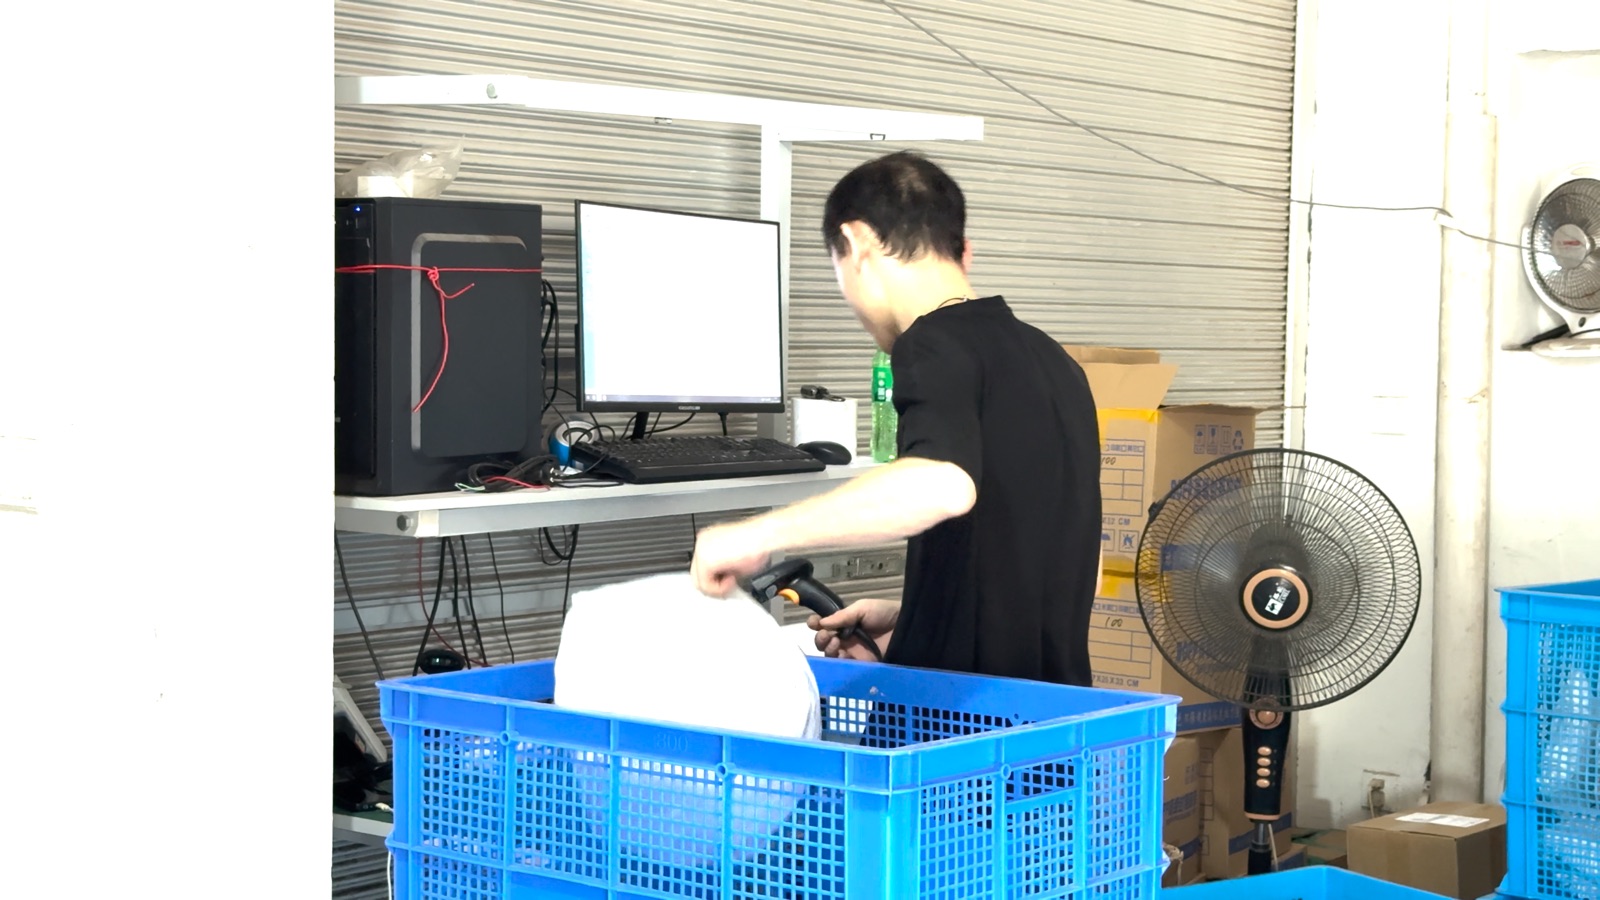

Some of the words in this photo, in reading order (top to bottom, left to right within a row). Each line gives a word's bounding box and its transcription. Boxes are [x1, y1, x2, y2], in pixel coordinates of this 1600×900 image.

[1118, 517, 1131, 527] CM
[1105, 616, 1123, 628] 100
[1126, 678, 1139, 688] CM
